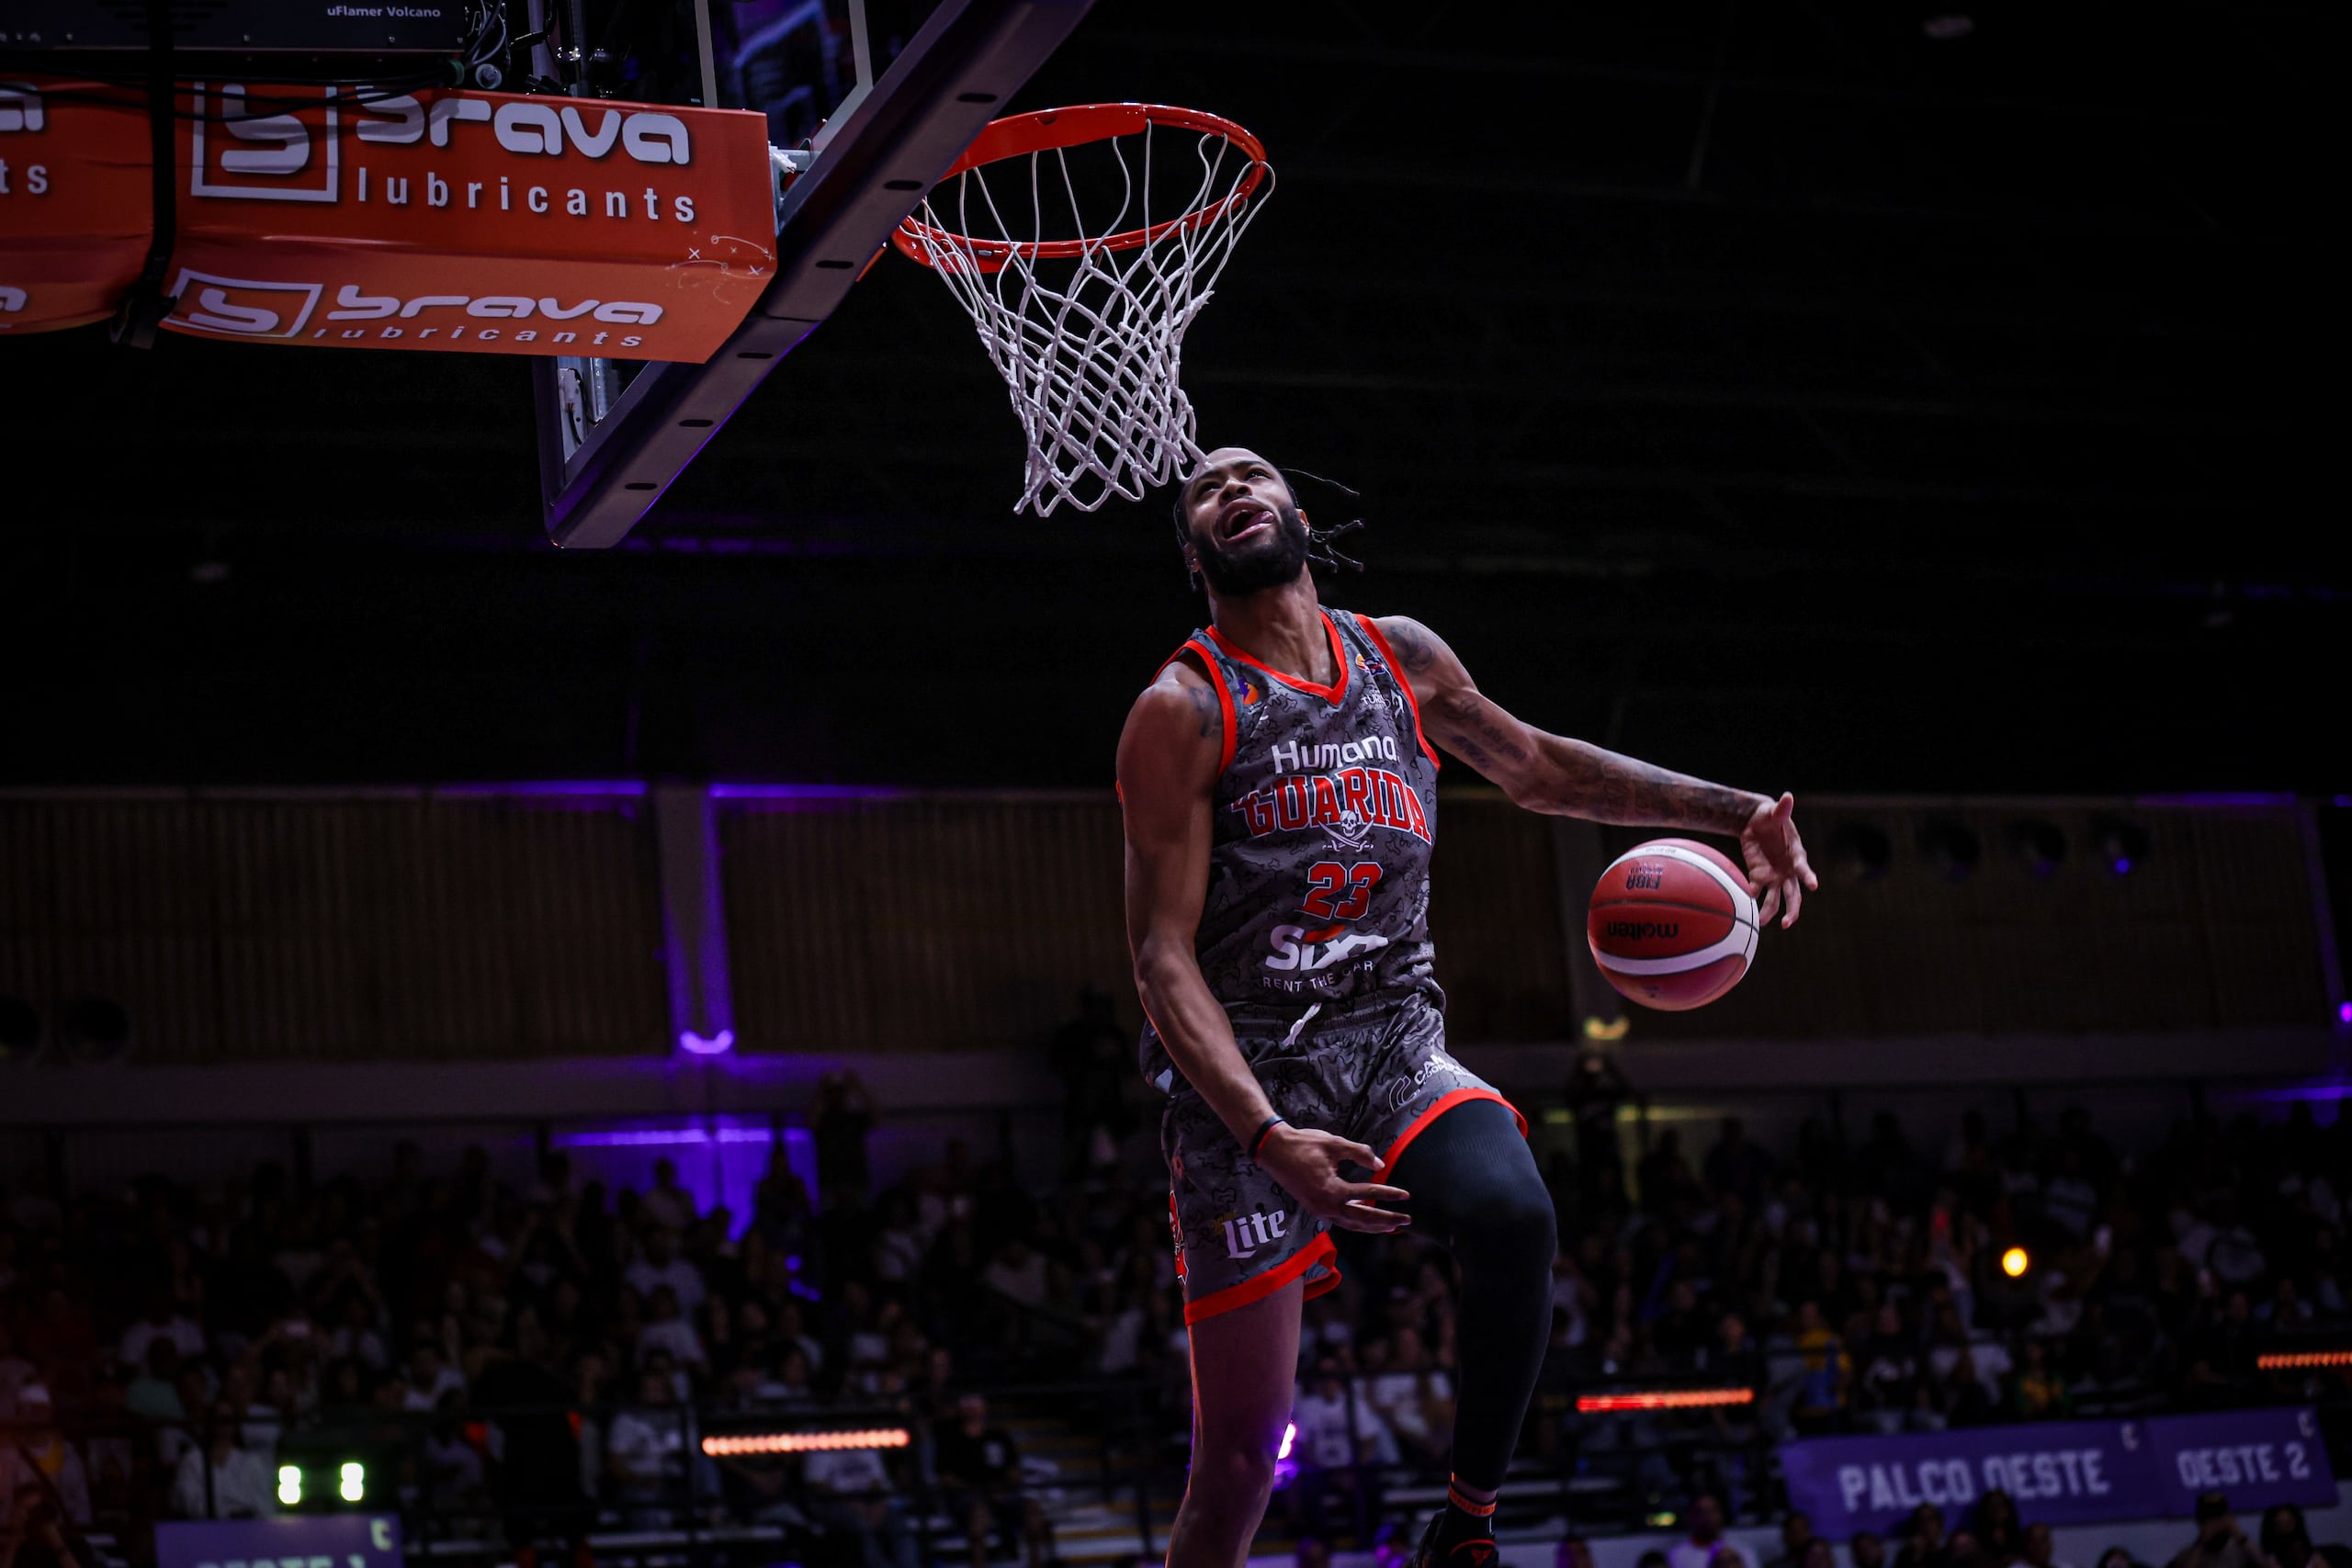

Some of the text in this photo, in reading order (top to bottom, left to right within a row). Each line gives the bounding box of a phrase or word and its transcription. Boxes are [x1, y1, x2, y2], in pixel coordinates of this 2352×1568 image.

[326, 5, 441, 17] uFlamer Volcano
[356, 165, 695, 223] lubricants
[326, 284, 663, 326] brava
[312, 326, 643, 348] lubricants
[1229, 765, 1432, 847] GUARIDA
[1299, 860, 1384, 920] 23
[1607, 920, 1679, 942] molten
[1262, 976, 1303, 993] RENT
[1309, 973, 1337, 990] THE
[1220, 1208, 1287, 1260] Lite
[1838, 1446, 2110, 1514] PALCO OESTE
[2175, 1440, 2312, 1490] OESTE 2
